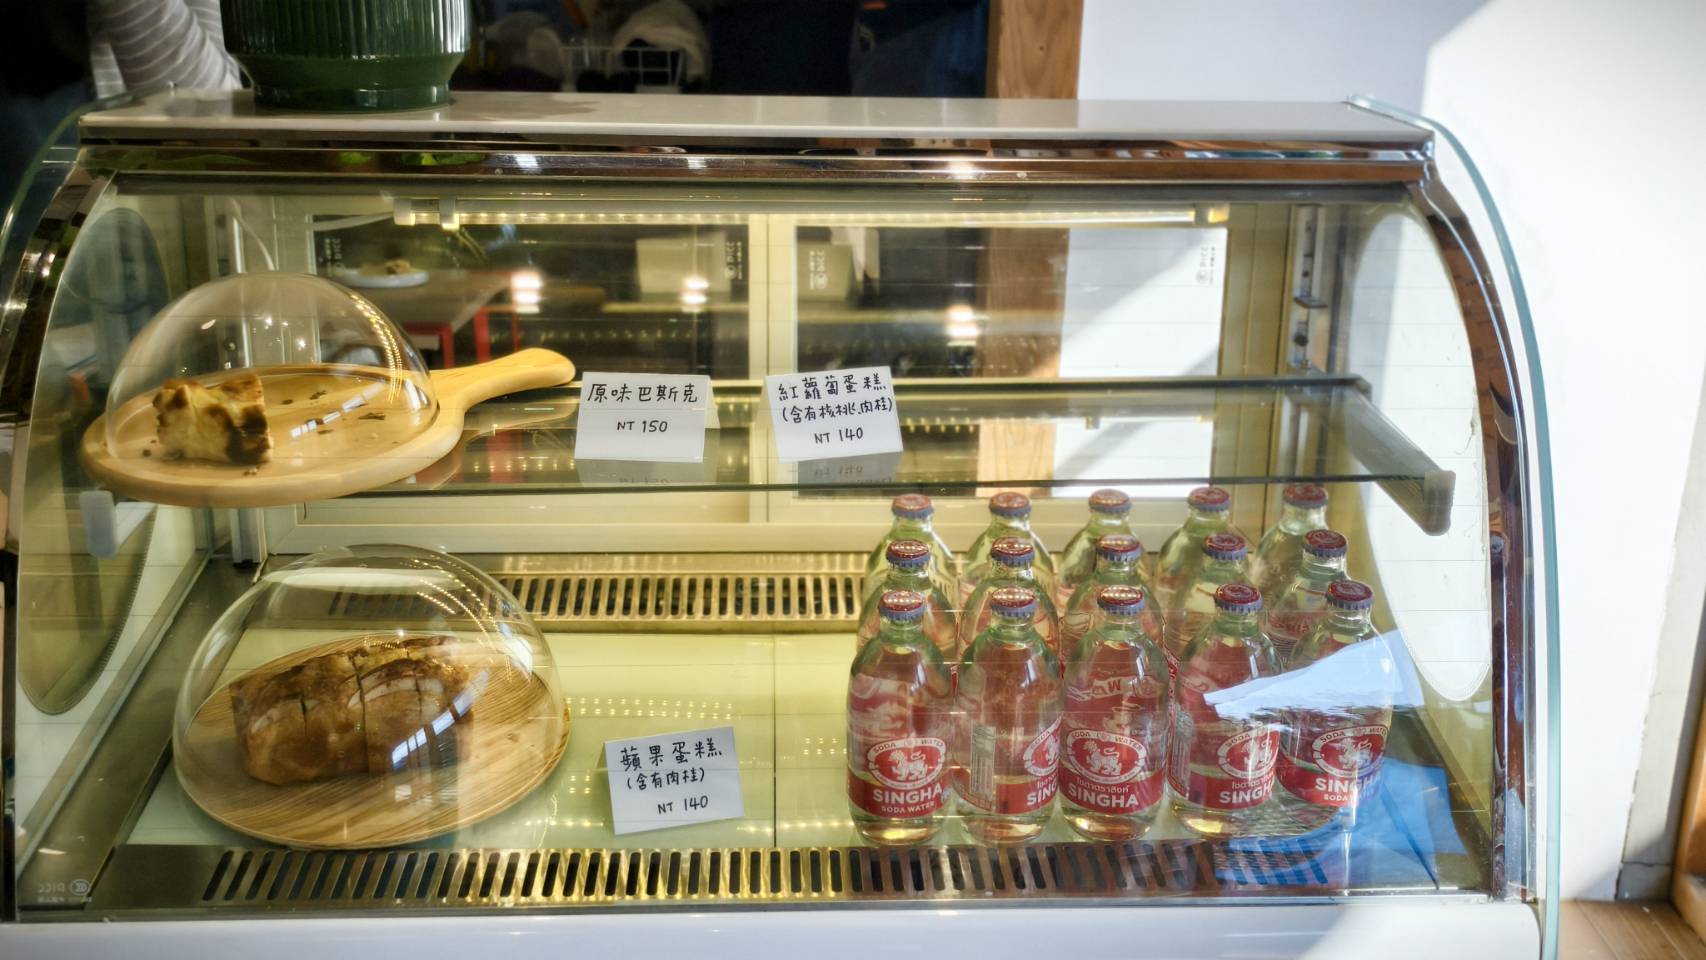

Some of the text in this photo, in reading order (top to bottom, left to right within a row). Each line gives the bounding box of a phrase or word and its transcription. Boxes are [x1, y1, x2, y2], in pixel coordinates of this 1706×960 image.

[587, 383, 698, 403] 原味巴斯克
[778, 373, 887, 401] 紅蘿蔔蛋糕
[617, 420, 668, 433] NT 150
[814, 427, 864, 444] NT 140
[1115, 735, 1143, 751] WATER
[1225, 733, 1251, 747] SODA
[1320, 731, 1345, 743] SODA
[620, 737, 722, 772] 蘋果蛋糕
[873, 742, 896, 753] SODA
[627, 767, 705, 790] (含有肉桂)
[873, 783, 943, 805] SINGHA
[1068, 783, 1139, 808] SINGHA
[657, 795, 709, 814] NT 140
